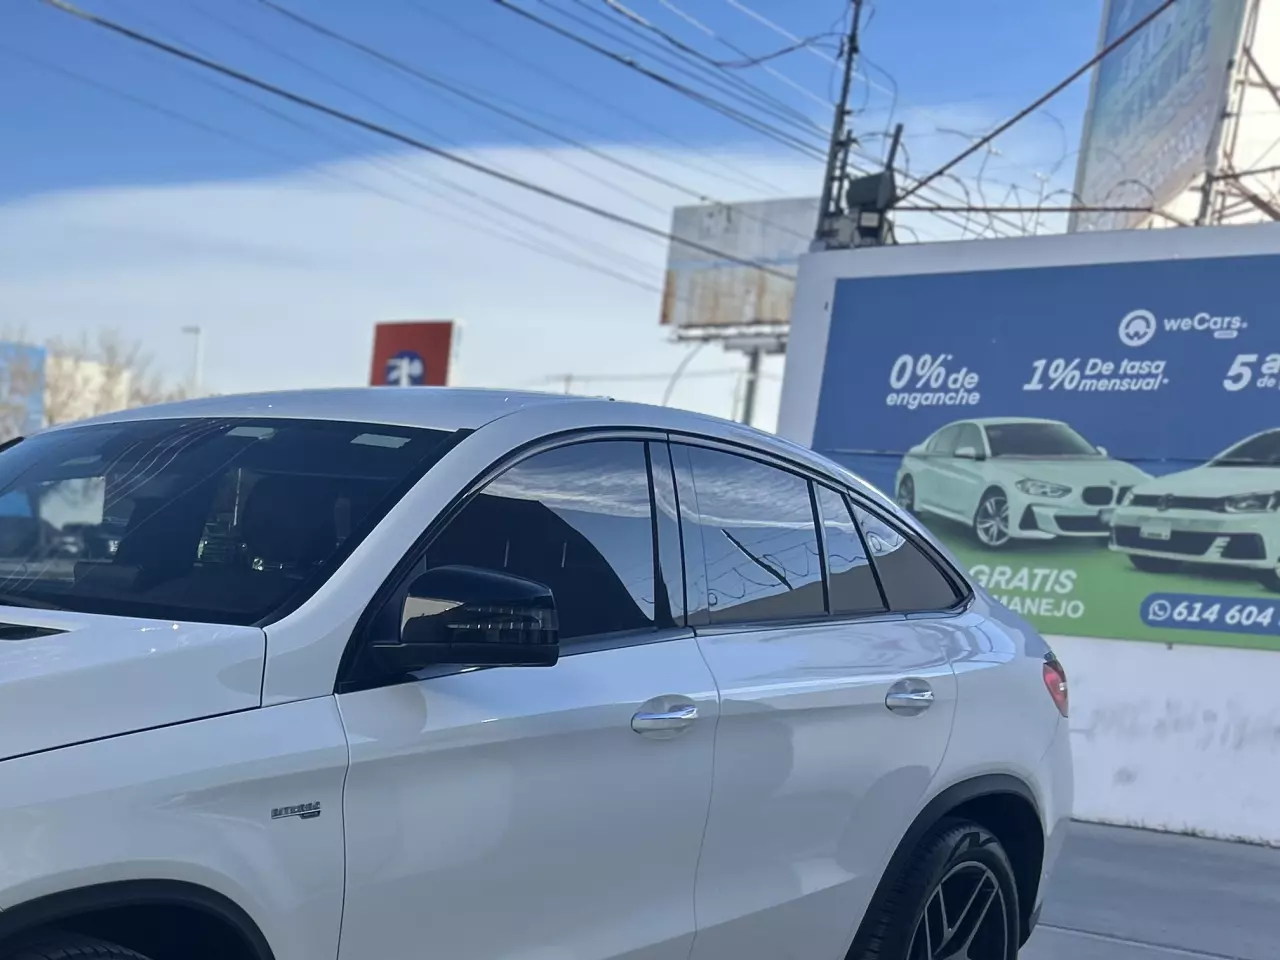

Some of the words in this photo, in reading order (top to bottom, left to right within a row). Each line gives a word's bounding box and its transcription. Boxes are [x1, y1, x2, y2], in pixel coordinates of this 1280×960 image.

[947, 367, 979, 389] de
[1023, 358, 1081, 390] 1%
[1085, 358, 1115, 375] De
[1119, 358, 1166, 375] tasa
[1223, 354, 1258, 391] 5
[886, 388, 980, 409] enganche
[969, 564, 1077, 594] GRATIS
[1172, 601, 1221, 623] 614
[1225, 605, 1275, 627] 604
